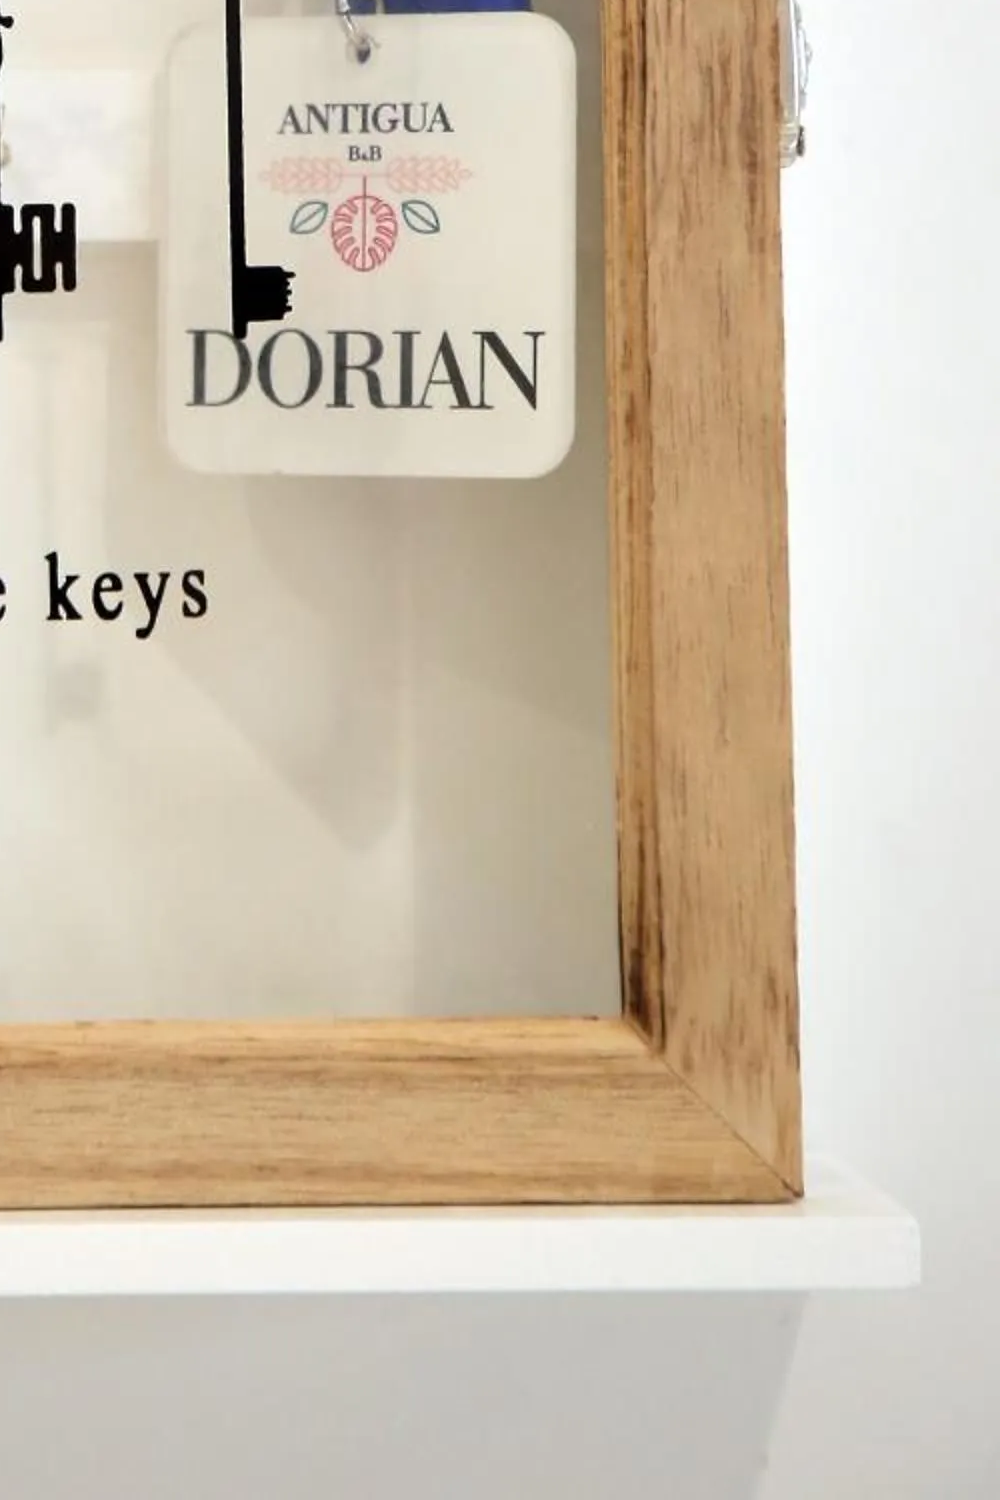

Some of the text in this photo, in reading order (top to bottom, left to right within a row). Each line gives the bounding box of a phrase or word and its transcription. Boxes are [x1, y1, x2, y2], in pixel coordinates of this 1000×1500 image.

[277, 103, 454, 134] ANTIGUA
[185, 328, 546, 411] DORIAN
[44, 551, 208, 639] keys
